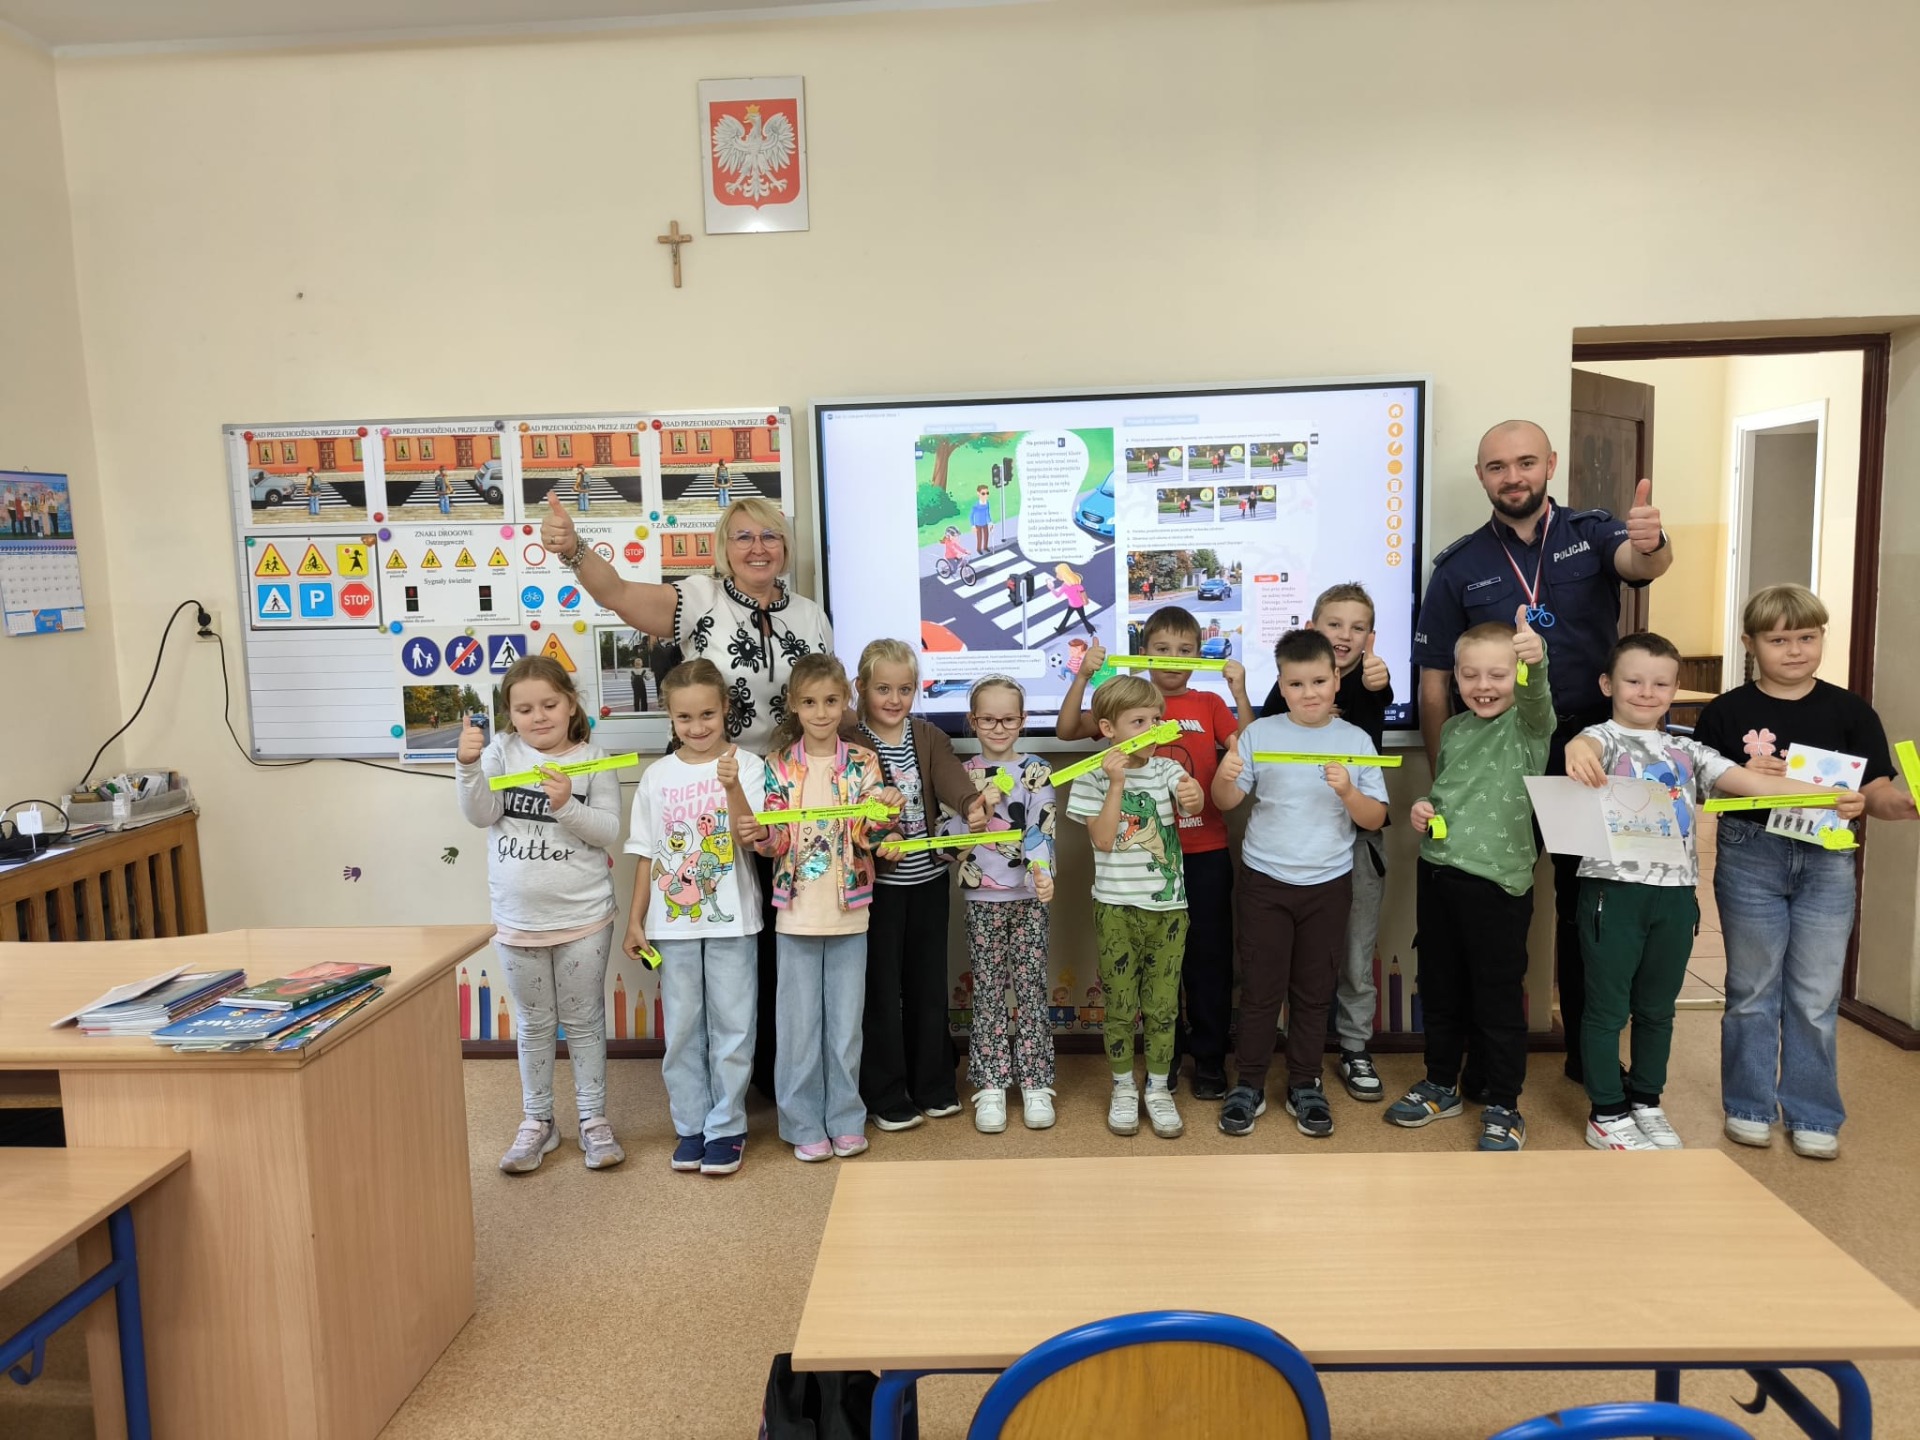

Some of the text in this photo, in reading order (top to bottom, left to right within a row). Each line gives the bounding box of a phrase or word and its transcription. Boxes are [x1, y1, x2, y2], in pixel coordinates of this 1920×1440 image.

[625, 548, 644, 556] STOP
[1552, 540, 1591, 563] POLICJA
[309, 589, 325, 609] P
[343, 594, 370, 606] STOP
[661, 778, 724, 804] FRIEND
[504, 791, 552, 816] WEEKE
[527, 822, 544, 837] IN
[1178, 816, 1204, 829] MARVEL
[498, 835, 576, 863] Glitter
